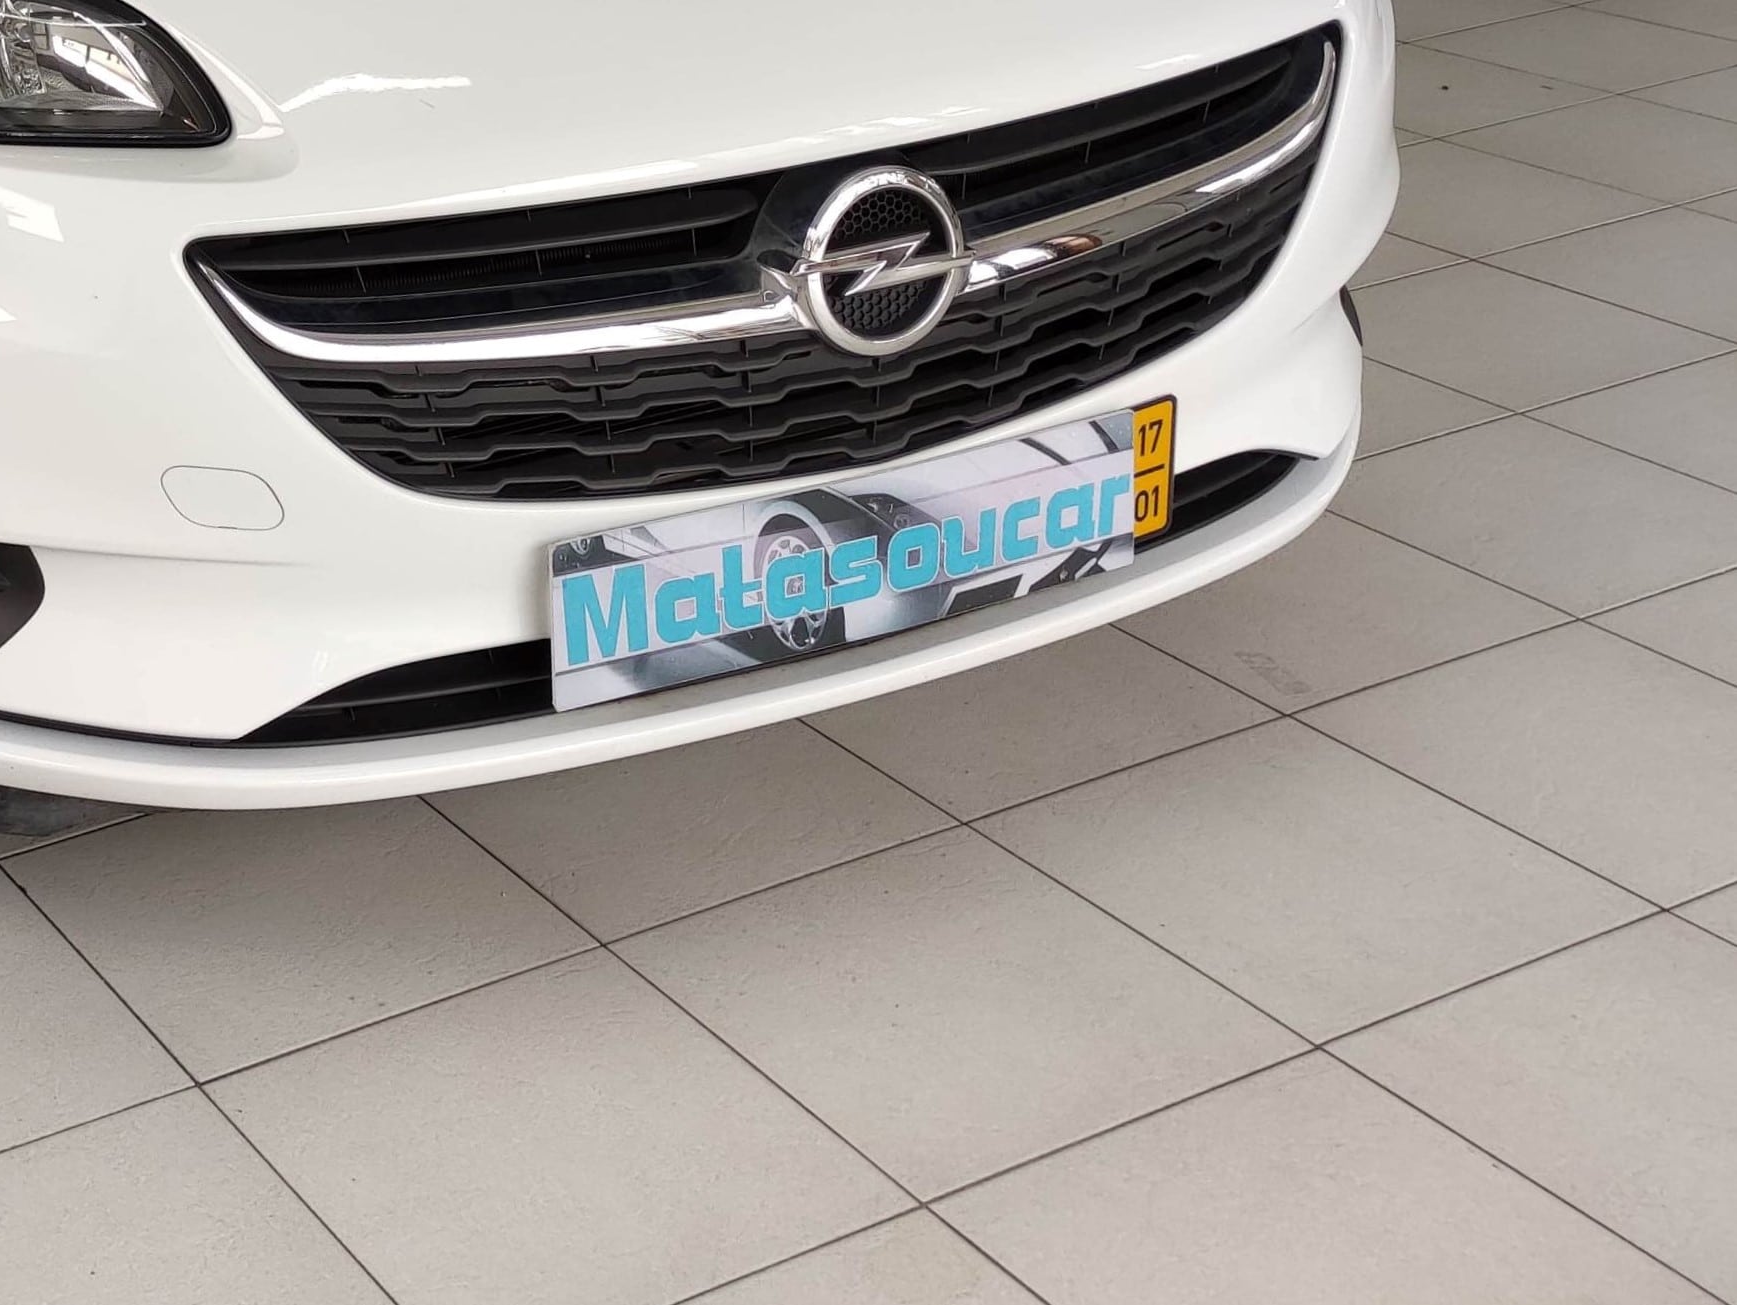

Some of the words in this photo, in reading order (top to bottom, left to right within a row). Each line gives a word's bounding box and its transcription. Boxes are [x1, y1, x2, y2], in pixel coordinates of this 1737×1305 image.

[1138, 419, 1163, 457] 17
[1134, 485, 1160, 522] 01
[561, 473, 1131, 666] Matasoucar
